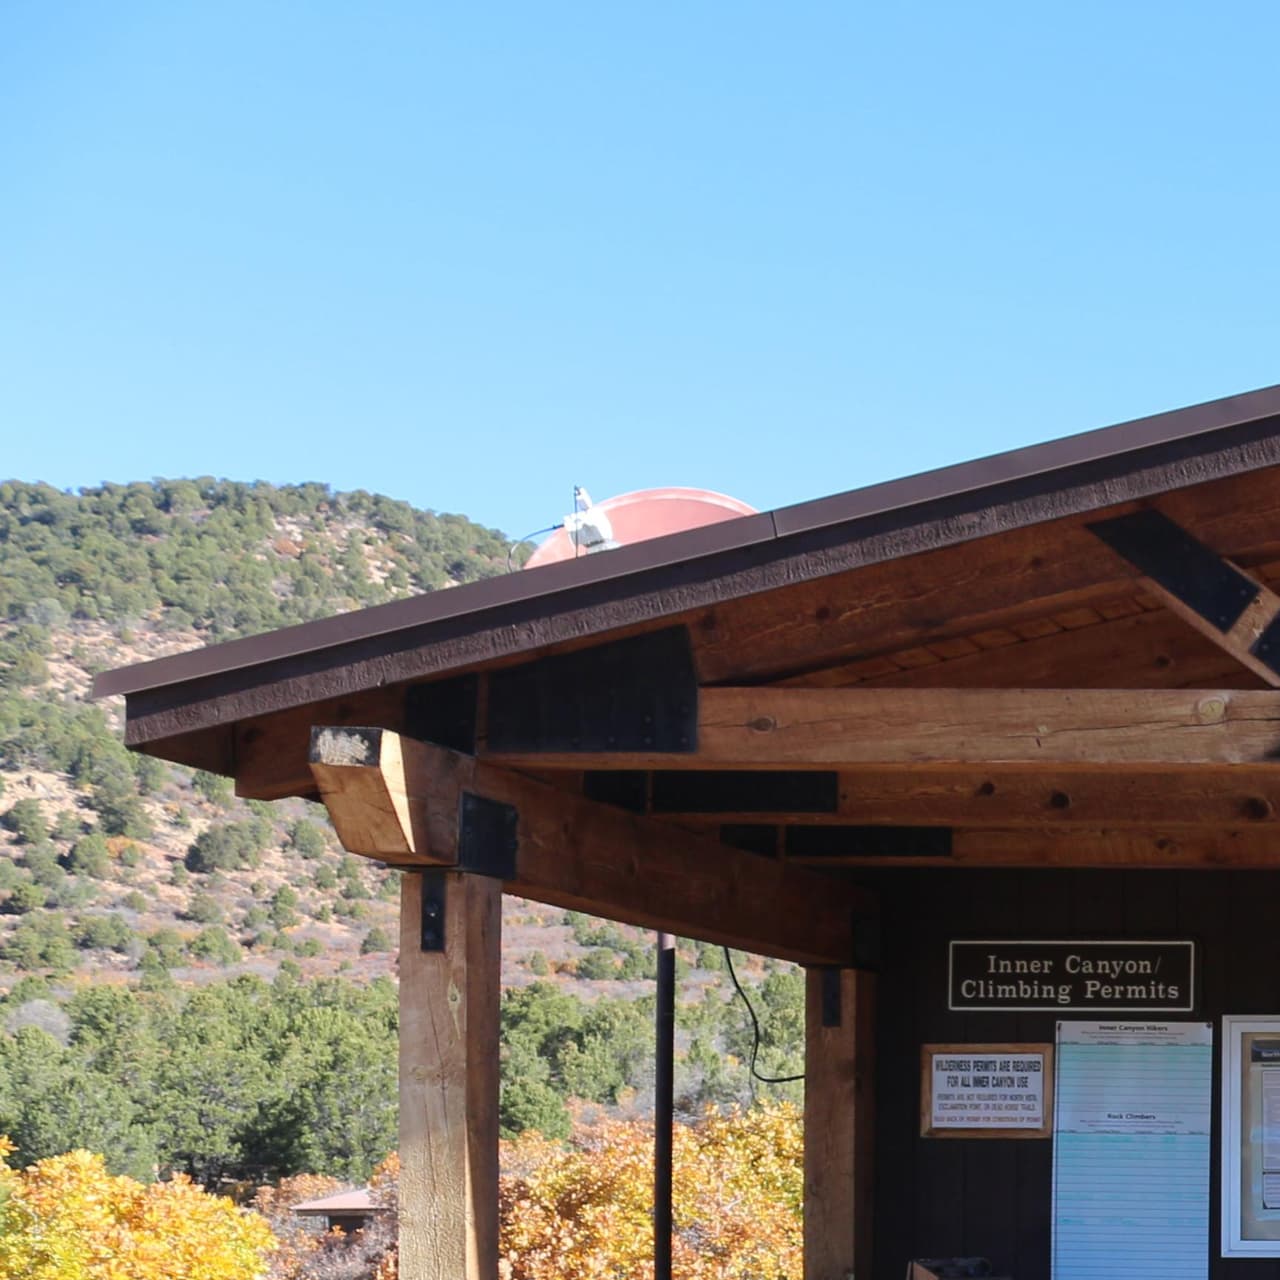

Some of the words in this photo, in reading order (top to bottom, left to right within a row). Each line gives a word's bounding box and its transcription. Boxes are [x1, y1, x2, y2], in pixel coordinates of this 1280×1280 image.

[987, 955, 1052, 973] Inner
[1065, 955, 1161, 978] Canyon/
[960, 979, 1072, 1003] Climbing
[1085, 980, 1179, 998] Permits
[973, 1060, 997, 1072] PERMITS
[999, 1060, 1011, 1072] ARE
[1012, 1060, 1041, 1072] REQUIRED
[947, 1076, 959, 1088] FOR
[960, 1076, 971, 1088] ALL
[991, 1076, 1015, 1088] CANYON
[1016, 1076, 1029, 1088] USE
